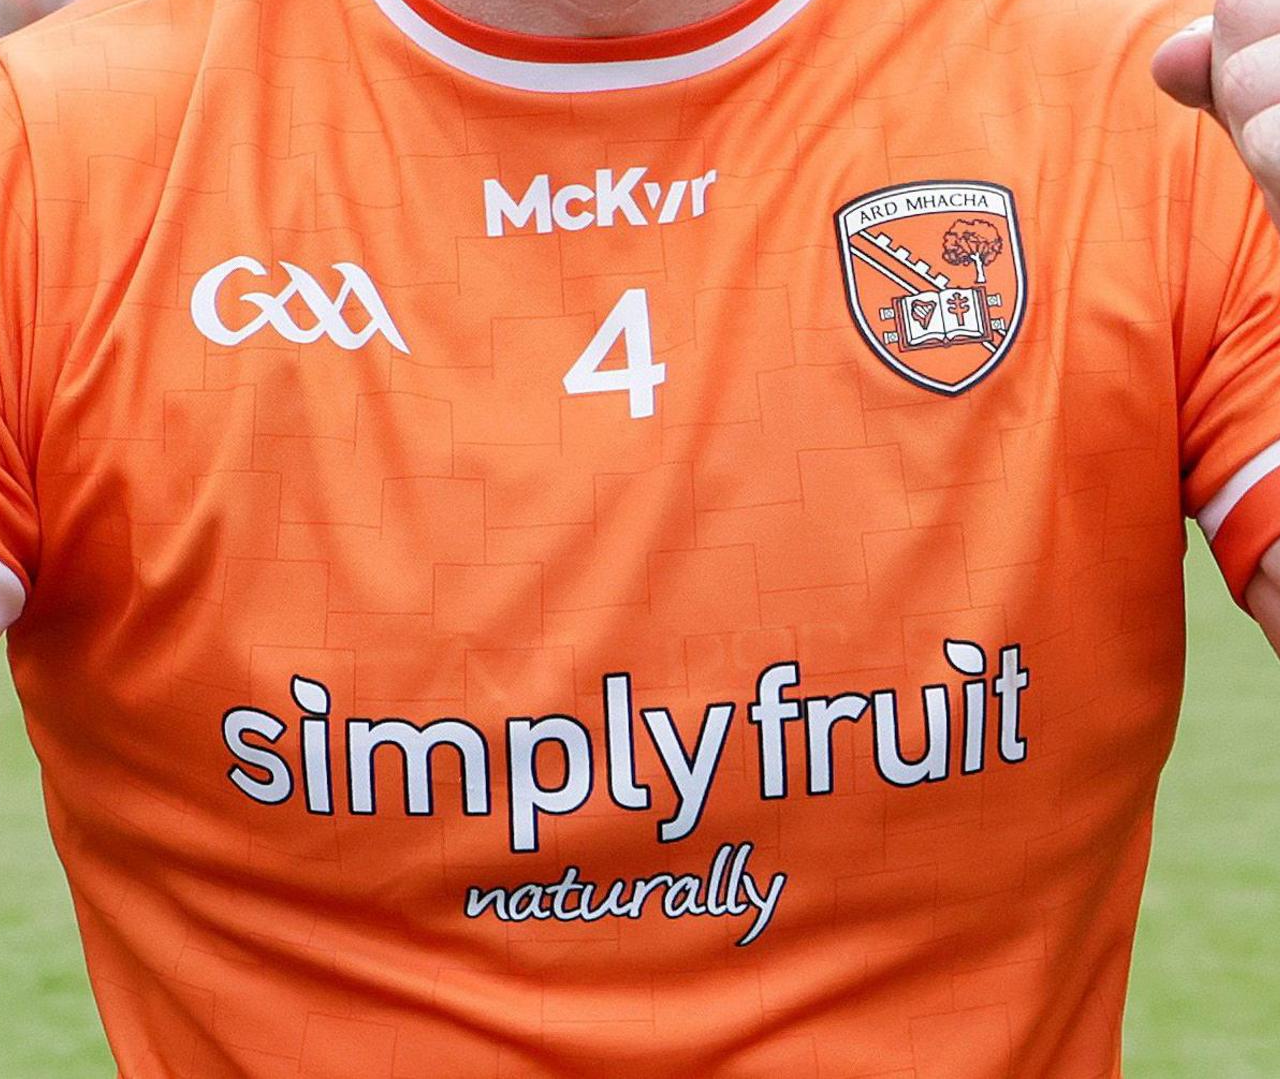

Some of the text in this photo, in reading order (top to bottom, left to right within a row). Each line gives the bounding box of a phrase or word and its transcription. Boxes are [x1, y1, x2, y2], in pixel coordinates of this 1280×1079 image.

[860, 193, 989, 224] ARD MHACHA
[190, 256, 410, 354] GAA
[563, 289, 667, 419] 4
[466, 845, 785, 945] naturally
